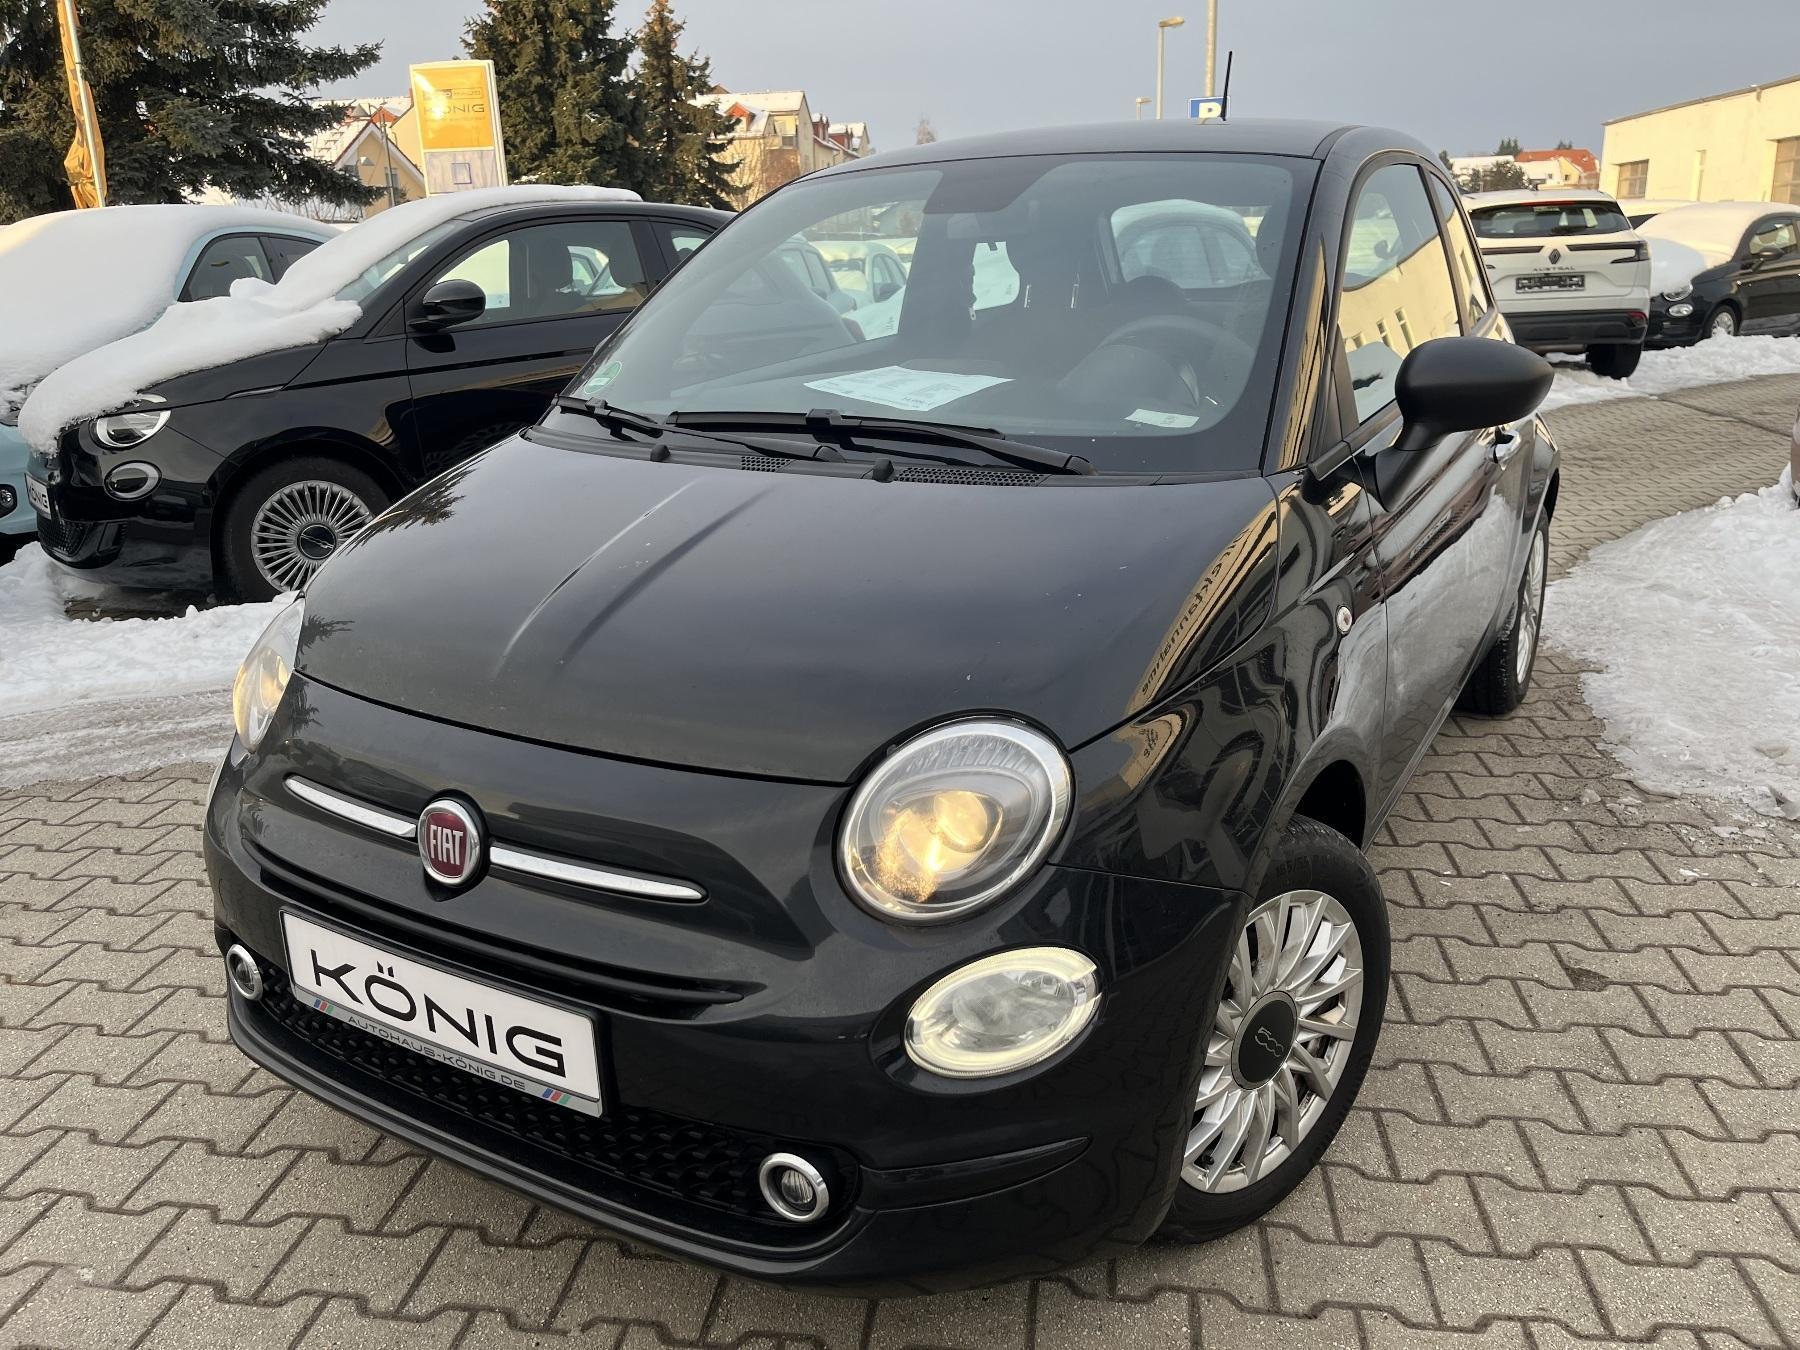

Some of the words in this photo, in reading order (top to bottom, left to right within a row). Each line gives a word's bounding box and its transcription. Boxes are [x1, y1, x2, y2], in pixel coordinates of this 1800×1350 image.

[1199, 102, 1221, 118] P
[430, 824, 464, 866] FIAT
[310, 948, 567, 1078] KÖNIG
[346, 1015, 526, 1091] AUTOHAUS-KÖNIG.DE
[1254, 1027, 1284, 1057] 500
